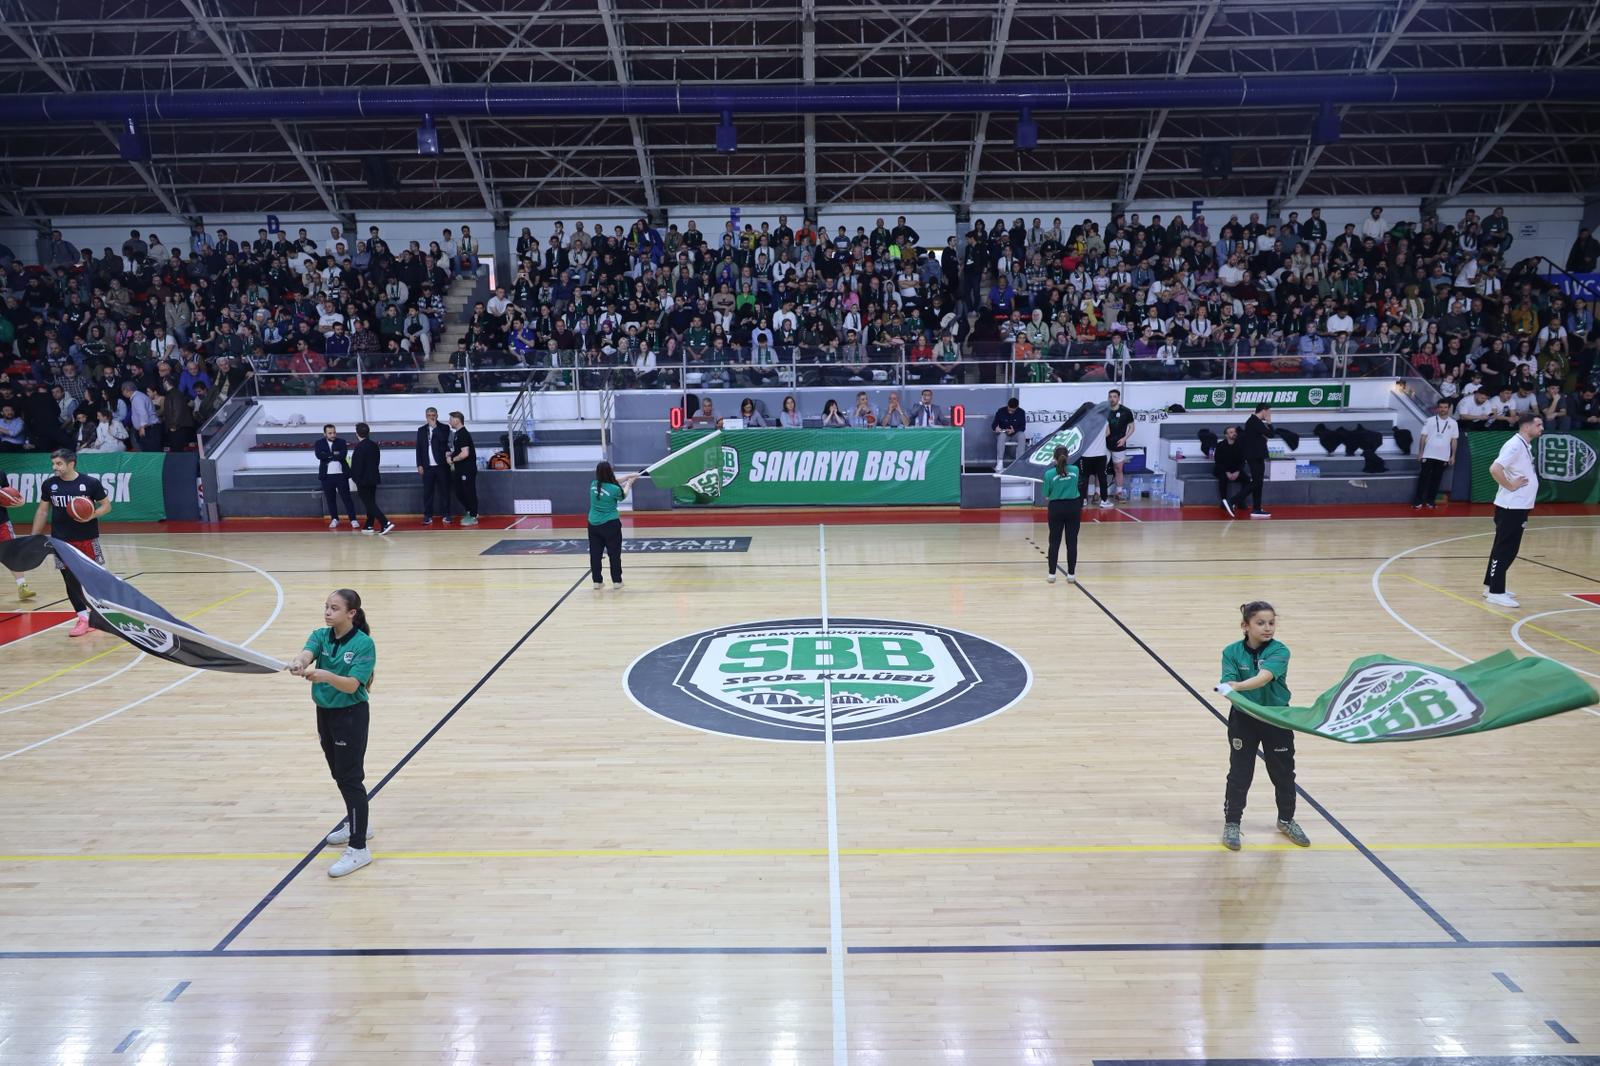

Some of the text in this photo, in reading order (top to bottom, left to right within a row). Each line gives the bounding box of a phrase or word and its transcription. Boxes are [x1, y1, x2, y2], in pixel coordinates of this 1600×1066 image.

[267, 215, 280, 234] D
[1234, 391, 1273, 403] SAKARYA
[1274, 391, 1298, 403] BBSK
[671, 408, 681, 428] 0
[953, 405, 964, 426] 0
[749, 450, 931, 482] SAKARYA BBSK
[719, 637, 935, 673] SBB
[723, 672, 935, 685] SPOR KULÜBÜ
